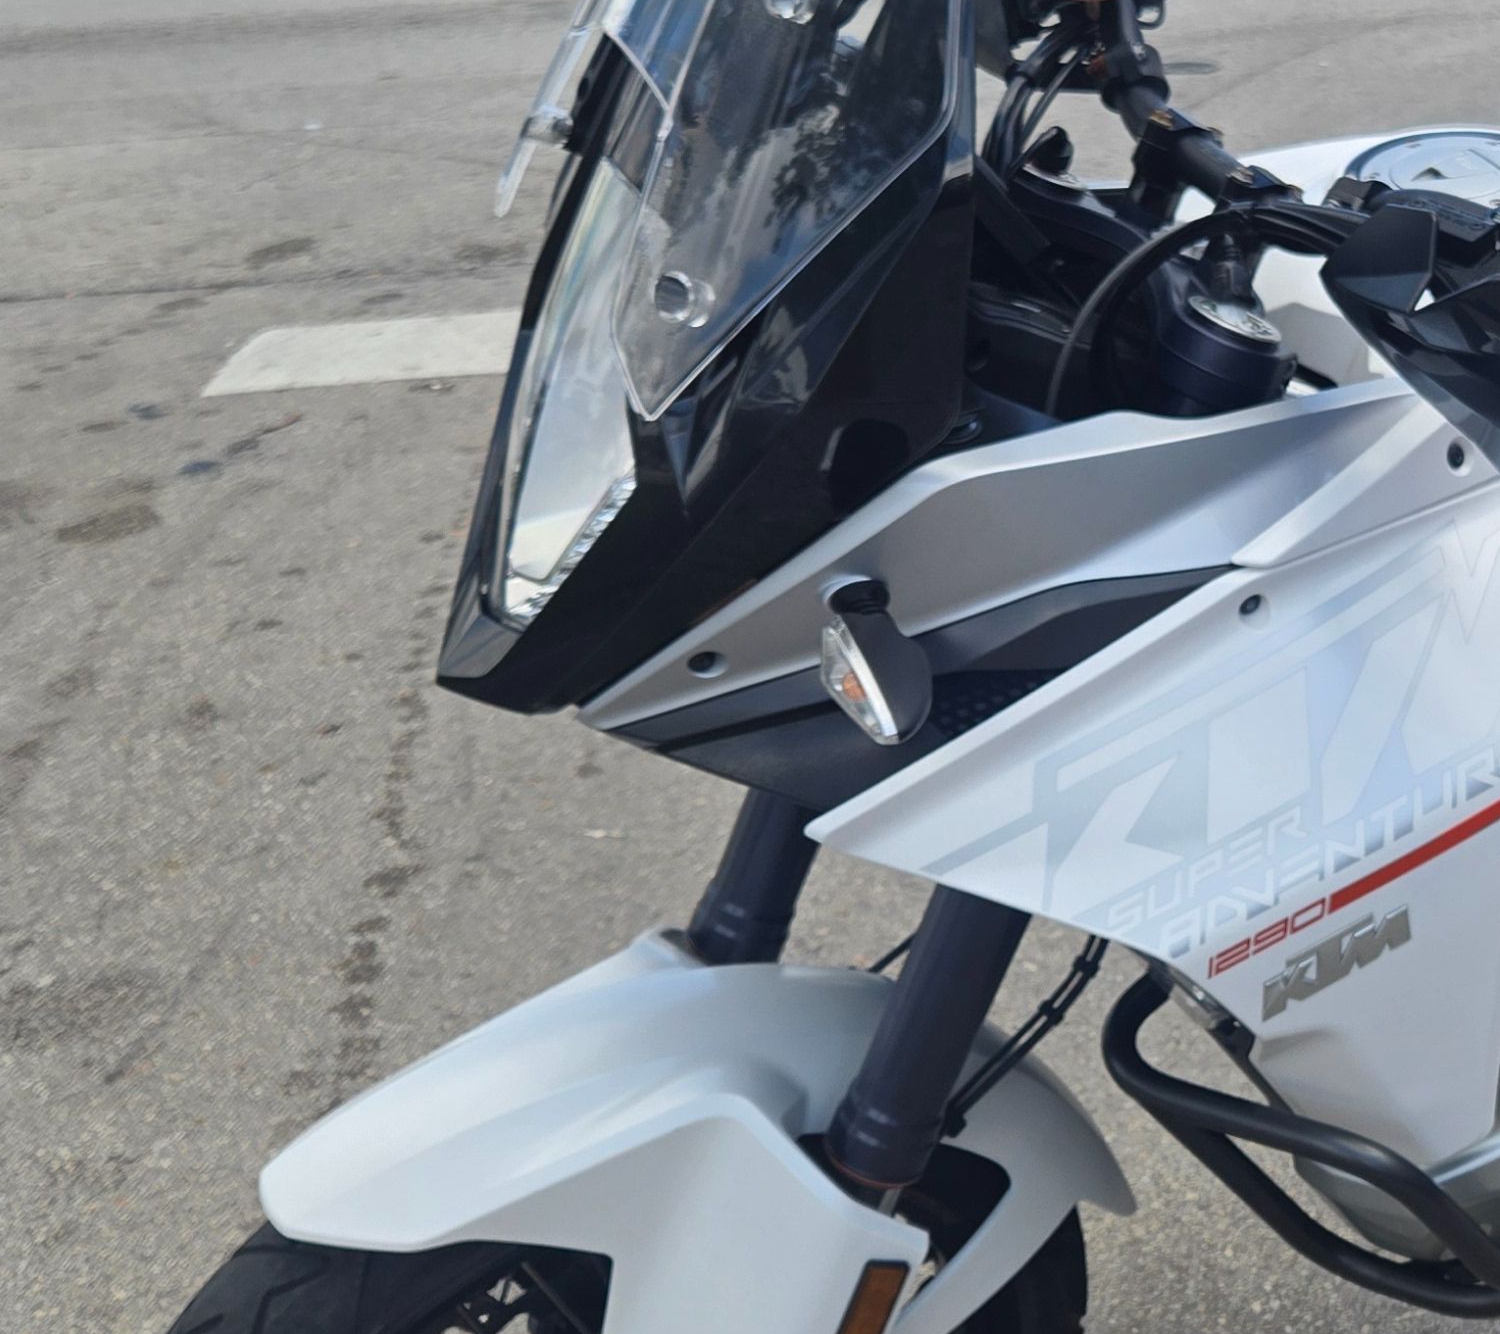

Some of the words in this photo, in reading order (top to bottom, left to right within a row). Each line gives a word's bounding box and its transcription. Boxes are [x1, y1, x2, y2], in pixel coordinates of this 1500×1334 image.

[1107, 805, 1312, 935] SUPER
[1207, 896, 1327, 979] 1290
[1261, 903, 1412, 1022] KTM
